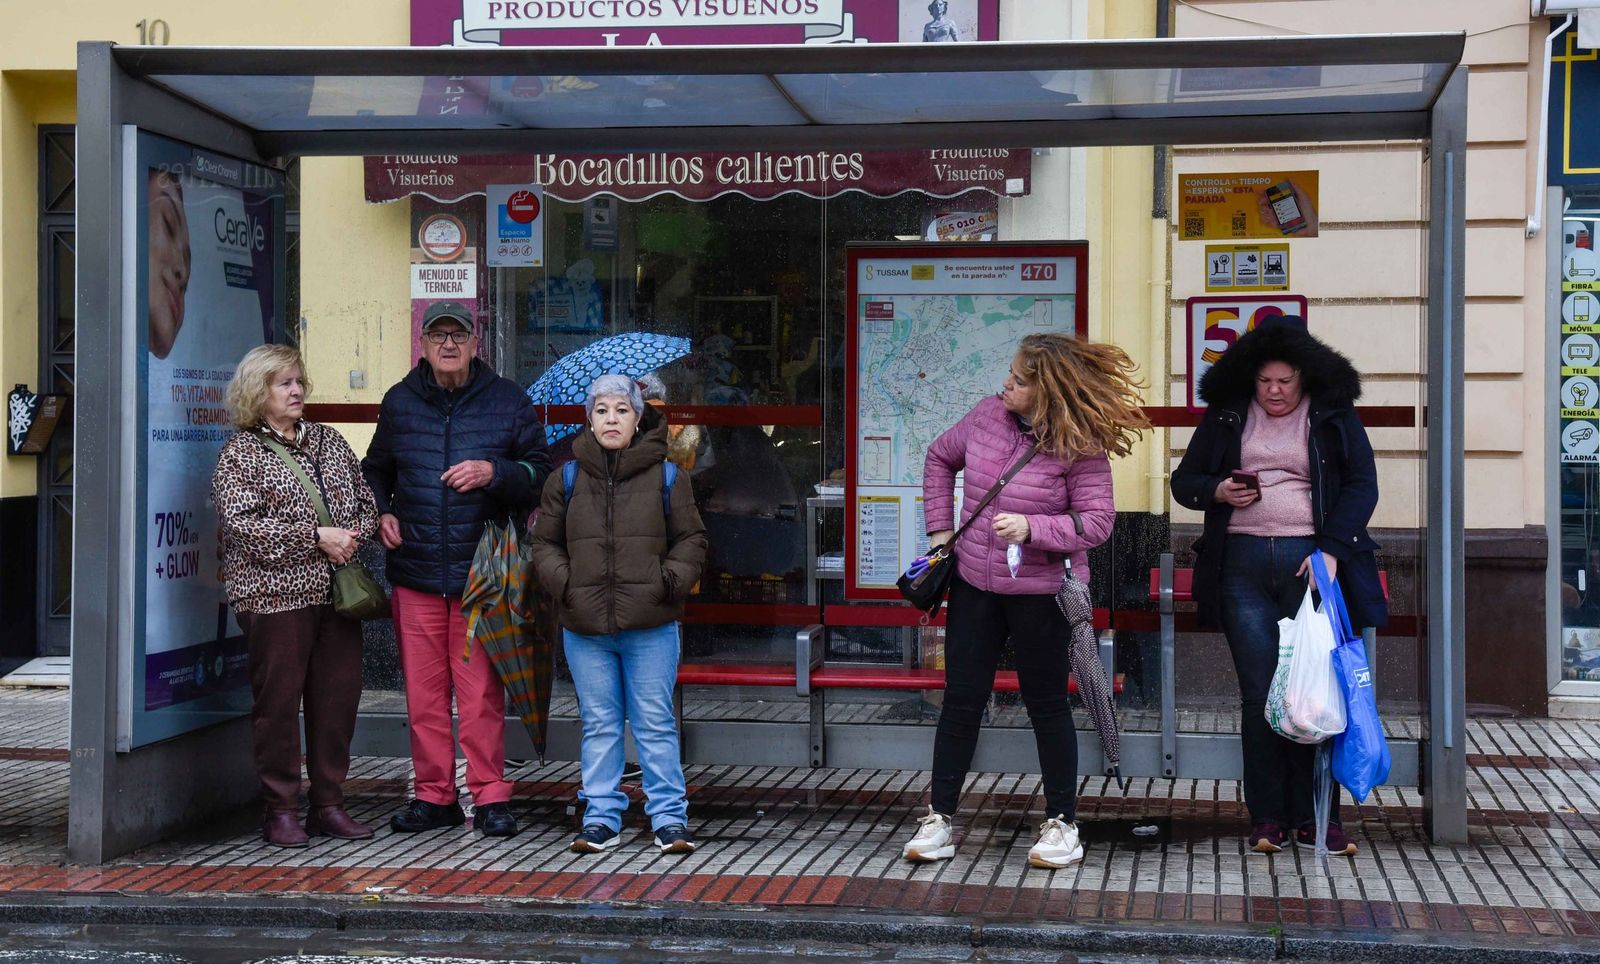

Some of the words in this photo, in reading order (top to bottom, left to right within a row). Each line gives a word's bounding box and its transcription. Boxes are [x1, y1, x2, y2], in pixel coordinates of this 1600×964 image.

[489, 0, 662, 19] PRODUCTOS
[136, 19, 170, 45] 10
[533, 153, 704, 186] Bocadillos
[716, 151, 864, 184] calientes
[934, 163, 1004, 181] Visueños
[387, 167, 454, 186] Visueños
[1185, 178, 1230, 186] CONTROLA
[1240, 177, 1271, 185] TIEMPO
[1192, 187, 1224, 195] ESPERA
[1233, 186, 1254, 194] ESTA
[1185, 196, 1226, 204] PARADA
[957, 217, 975, 229] 010
[214, 207, 265, 252] CeraVe
[500, 229, 526, 237] Espacio
[419, 269, 455, 280] MENUDO
[457, 269, 468, 280] DE
[876, 269, 909, 277] TUSSAM
[1022, 265, 1054, 280] 470
[970, 272, 996, 280] parada
[424, 282, 463, 293] TERNERA
[1569, 323, 1593, 332] MÓVIL
[173, 368, 181, 379] LOS
[198, 370, 205, 380] DE
[206, 371, 212, 380] LA
[171, 384, 187, 403] 10%
[186, 408, 191, 426] Y
[192, 408, 232, 426] CERAMIDA
[1563, 408, 1595, 417] ENERGÍA
[152, 429, 171, 442] PARA
[171, 429, 183, 442] UNA
[183, 429, 209, 442] BARRERA
[209, 430, 217, 442] DE
[217, 430, 224, 441] LA
[167, 550, 200, 580] GLOW
[75, 748, 96, 758] 677
